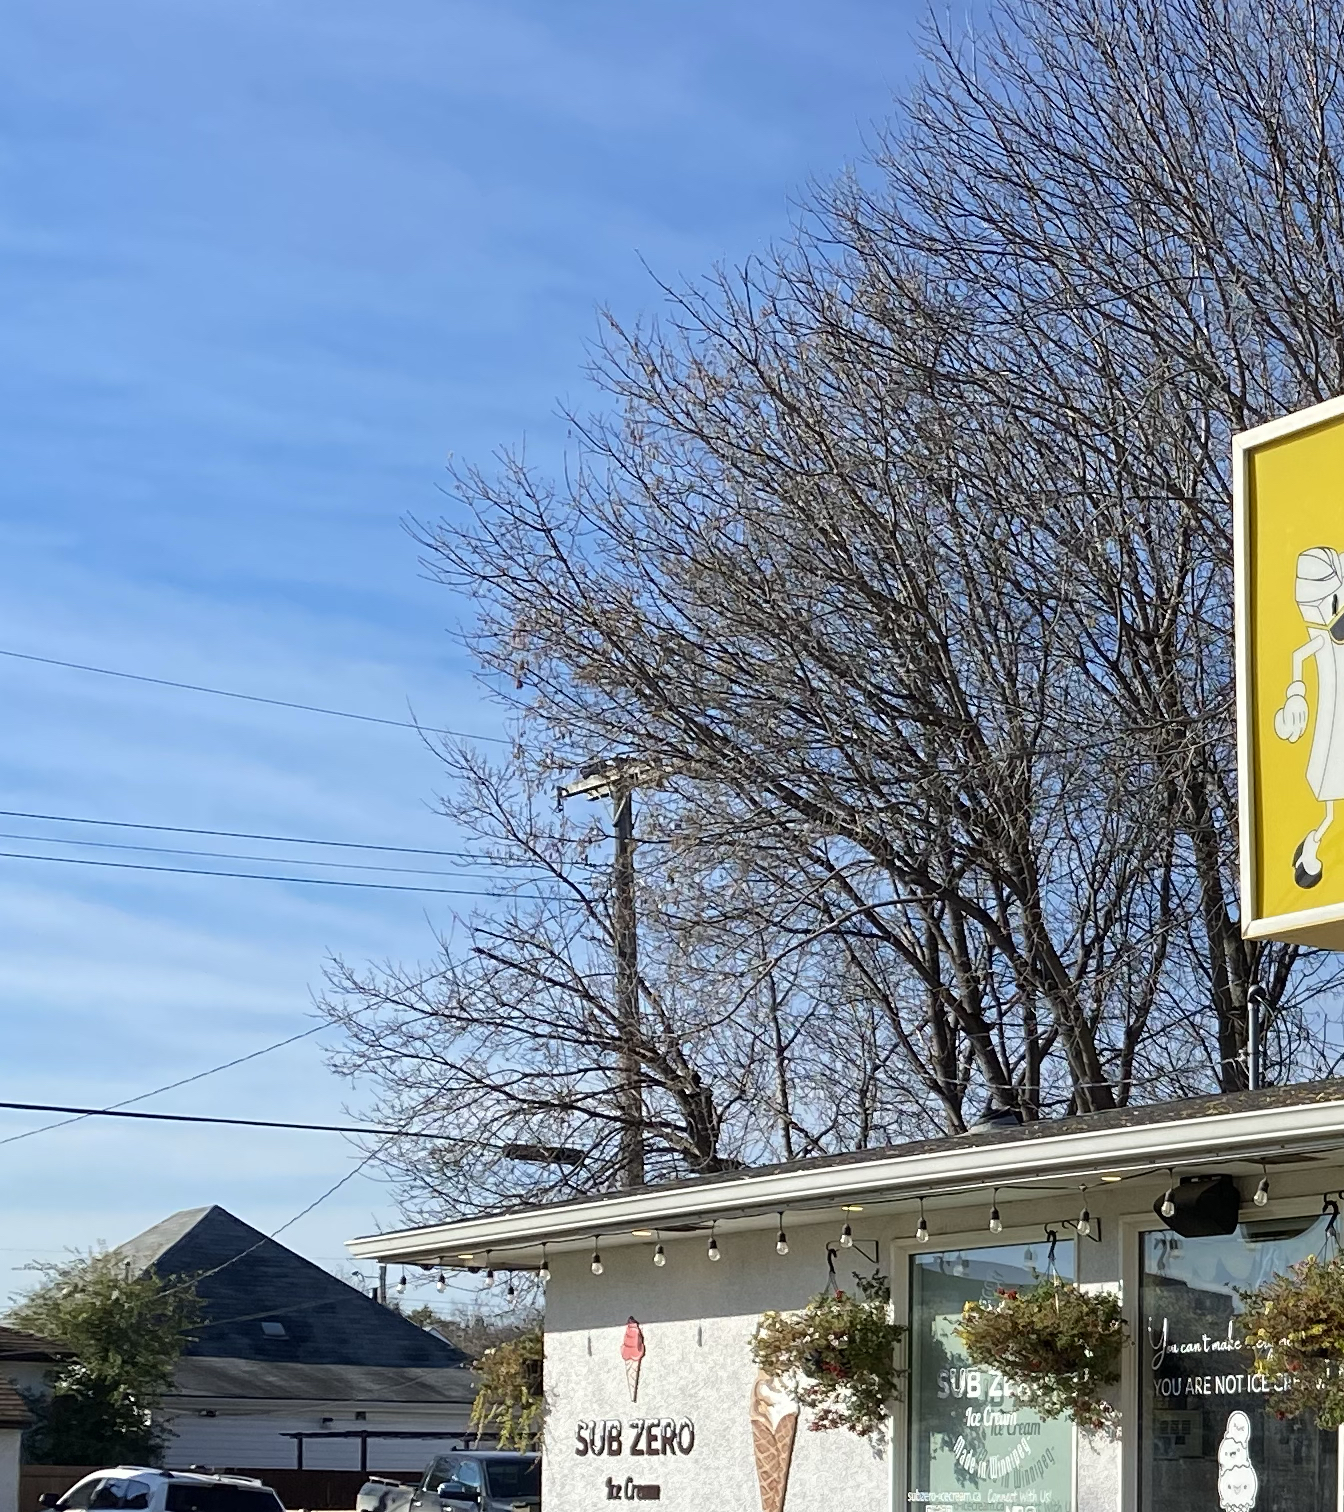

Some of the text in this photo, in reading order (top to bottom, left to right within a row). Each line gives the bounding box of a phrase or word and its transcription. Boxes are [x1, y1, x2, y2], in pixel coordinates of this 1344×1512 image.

[1147, 1316, 1178, 1371] You
[1212, 1320, 1242, 1352] make
[937, 1367, 981, 1398] SUB
[1153, 1377, 1182, 1396] YOU
[1185, 1376, 1212, 1395] ARE
[1214, 1374, 1244, 1394] NOT
[1247, 1373, 1270, 1393] ICE
[965, 1405, 1017, 1426] Ice Cream
[575, 1415, 695, 1457] SUB ZERO
[953, 1435, 976, 1474] Made
[977, 1460, 987, 1480] in
[605, 1476, 622, 1500] Ice
[987, 1488, 1018, 1504] Connect
